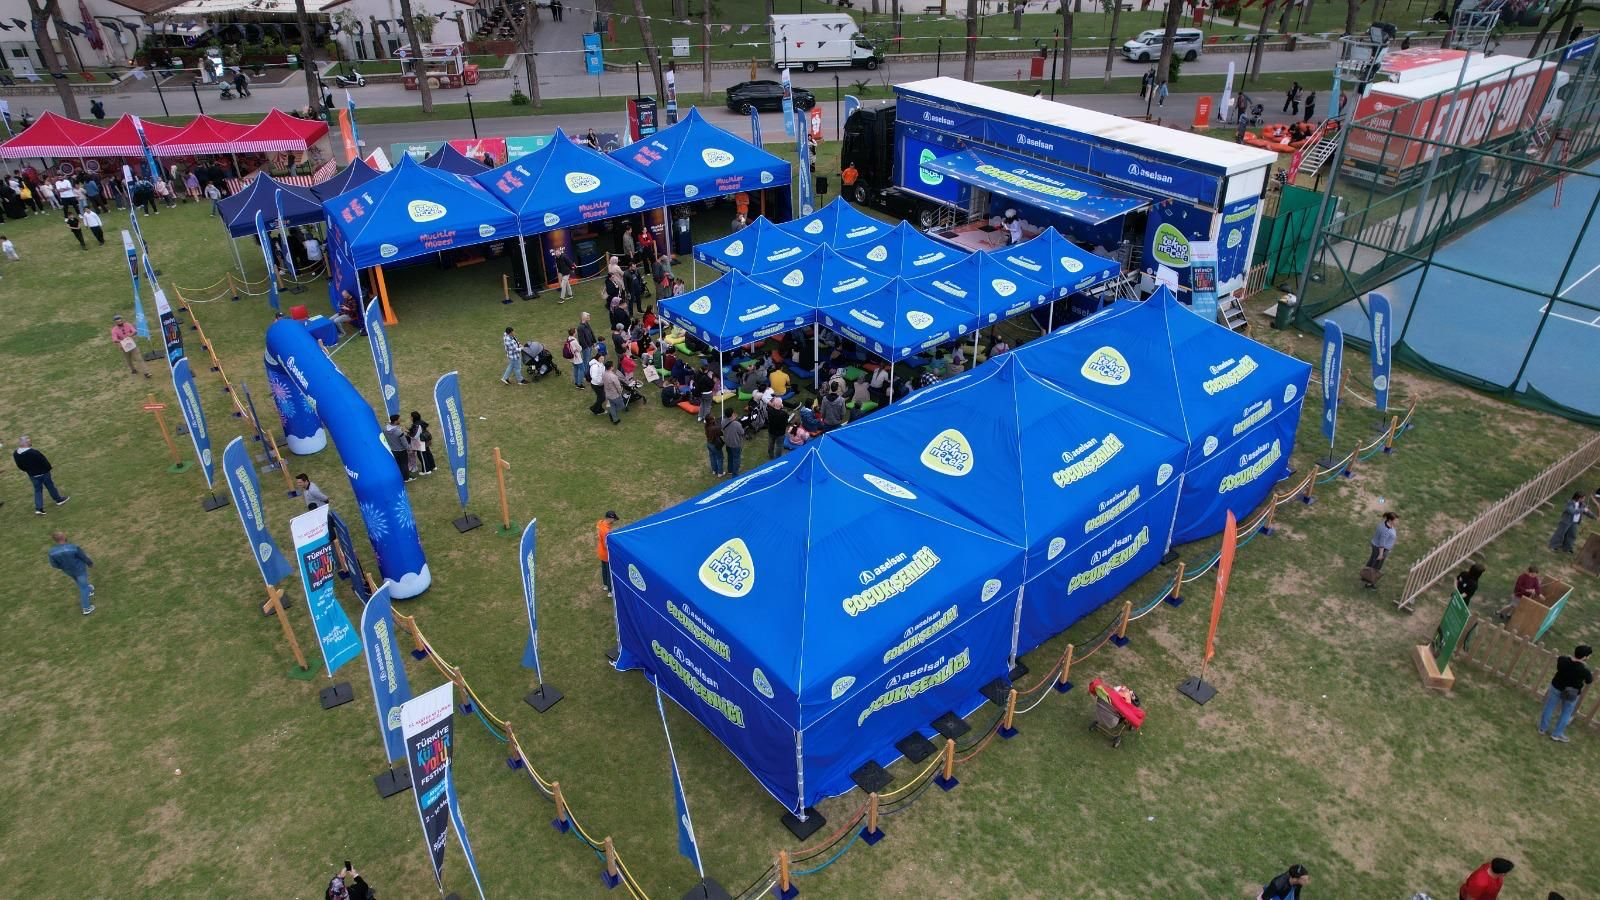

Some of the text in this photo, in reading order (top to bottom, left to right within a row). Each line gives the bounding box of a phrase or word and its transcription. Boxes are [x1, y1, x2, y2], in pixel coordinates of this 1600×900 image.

[931, 114, 955, 126] aselsan
[1026, 138, 1054, 151] aselsan
[1140, 168, 1173, 183] aselsan
[579, 201, 611, 212] Mucitler
[420, 230, 457, 243] Mucitler
[424, 239, 453, 249] Müzesi
[1162, 235, 1188, 252] tekno
[1158, 244, 1188, 264] macera
[1089, 362, 1122, 381] macera
[1098, 356, 1125, 374] tekno
[929, 447, 965, 471] macera
[940, 440, 969, 463] tekno
[1071, 438, 1098, 458] aselsan
[1248, 442, 1270, 461] aselsan
[1053, 460, 1091, 488] ÇOCUK
[306, 544, 332, 561] TÜRKİYE
[874, 552, 907, 576] aselsan
[709, 559, 743, 591] macera
[720, 551, 750, 580] tekno
[843, 545, 941, 616] ÇOCUK ŞENLİĞİ
[690, 611, 715, 636] aselsan
[914, 611, 941, 631] aselsan
[374, 643, 384, 673] aselsan
[883, 634, 922, 665] ÇOCUK
[685, 657, 719, 690] aselsan
[902, 655, 945, 680] aselsan
[907, 647, 971, 699] ŞENLİĞİ
[651, 639, 745, 728] ÇOCUK ŞENLİĞİ
[416, 725, 449, 750] TÜRKİYE
[417, 734, 450, 767] KÜLTÜR
[424, 747, 448, 776] YOLU
